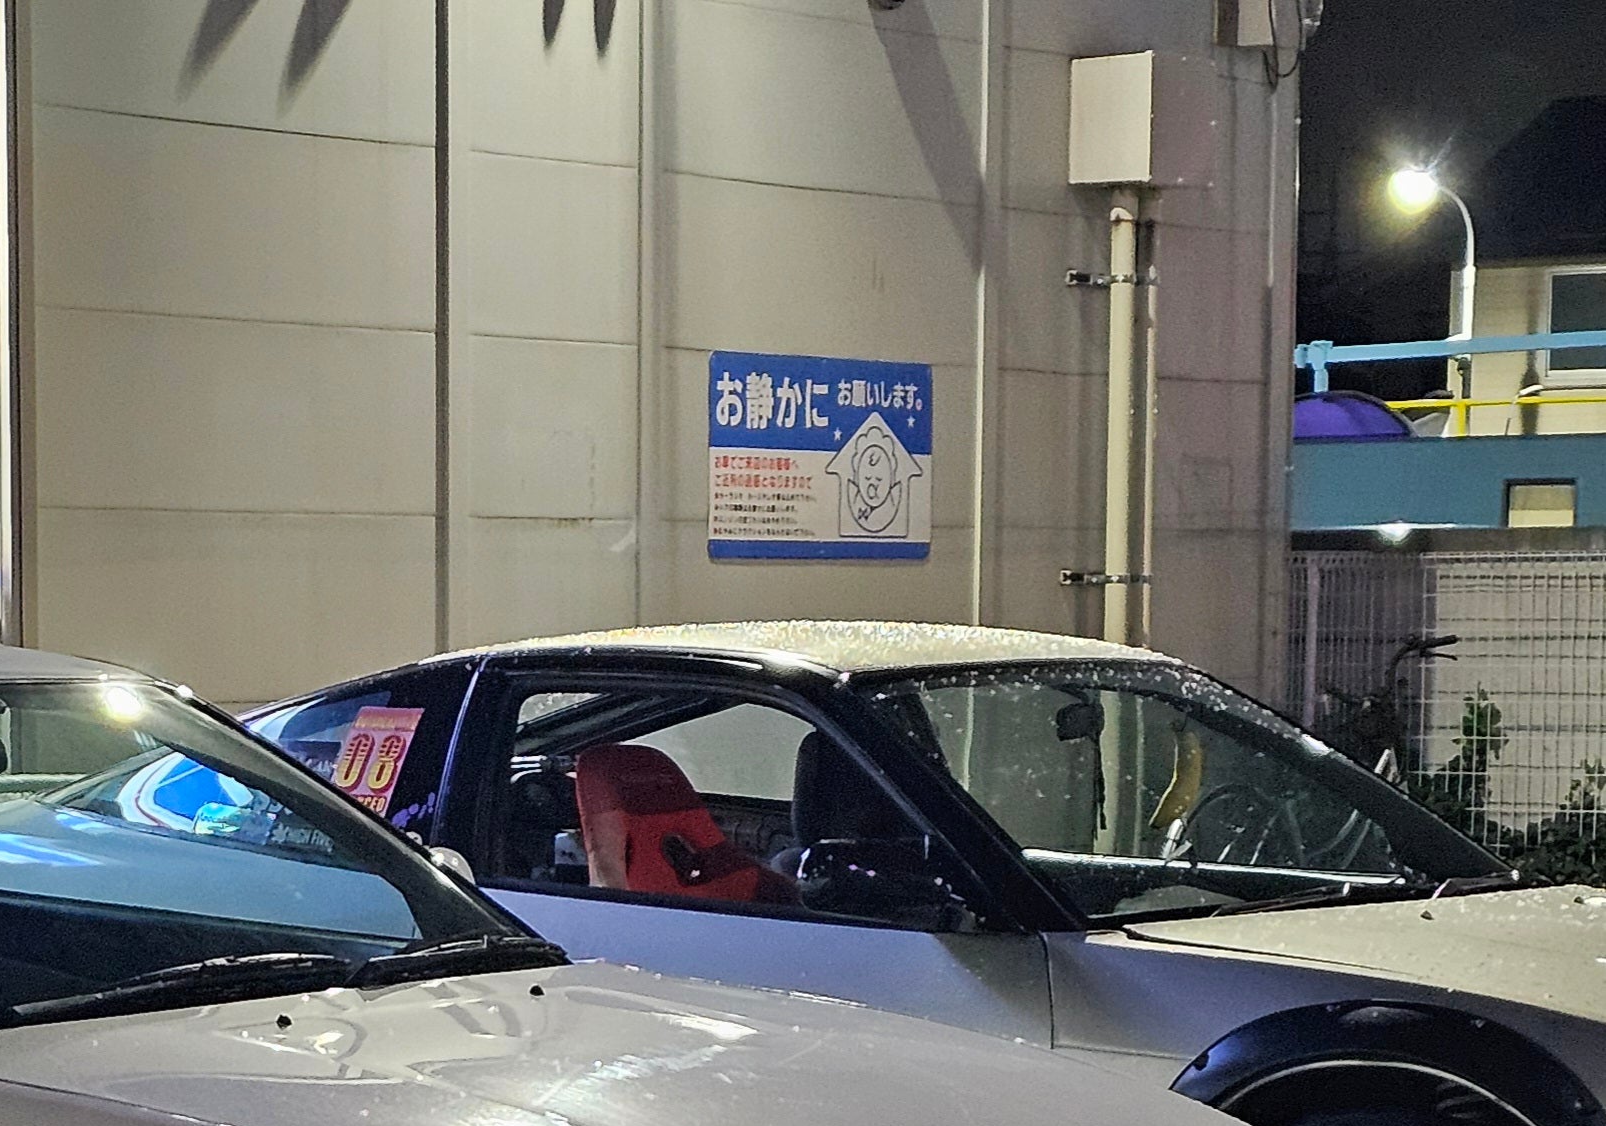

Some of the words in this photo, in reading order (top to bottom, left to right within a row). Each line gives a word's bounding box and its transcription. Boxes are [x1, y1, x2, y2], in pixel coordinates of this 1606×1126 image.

[715, 371, 831, 431] お静かに
[836, 377, 923, 412] お願いします。
